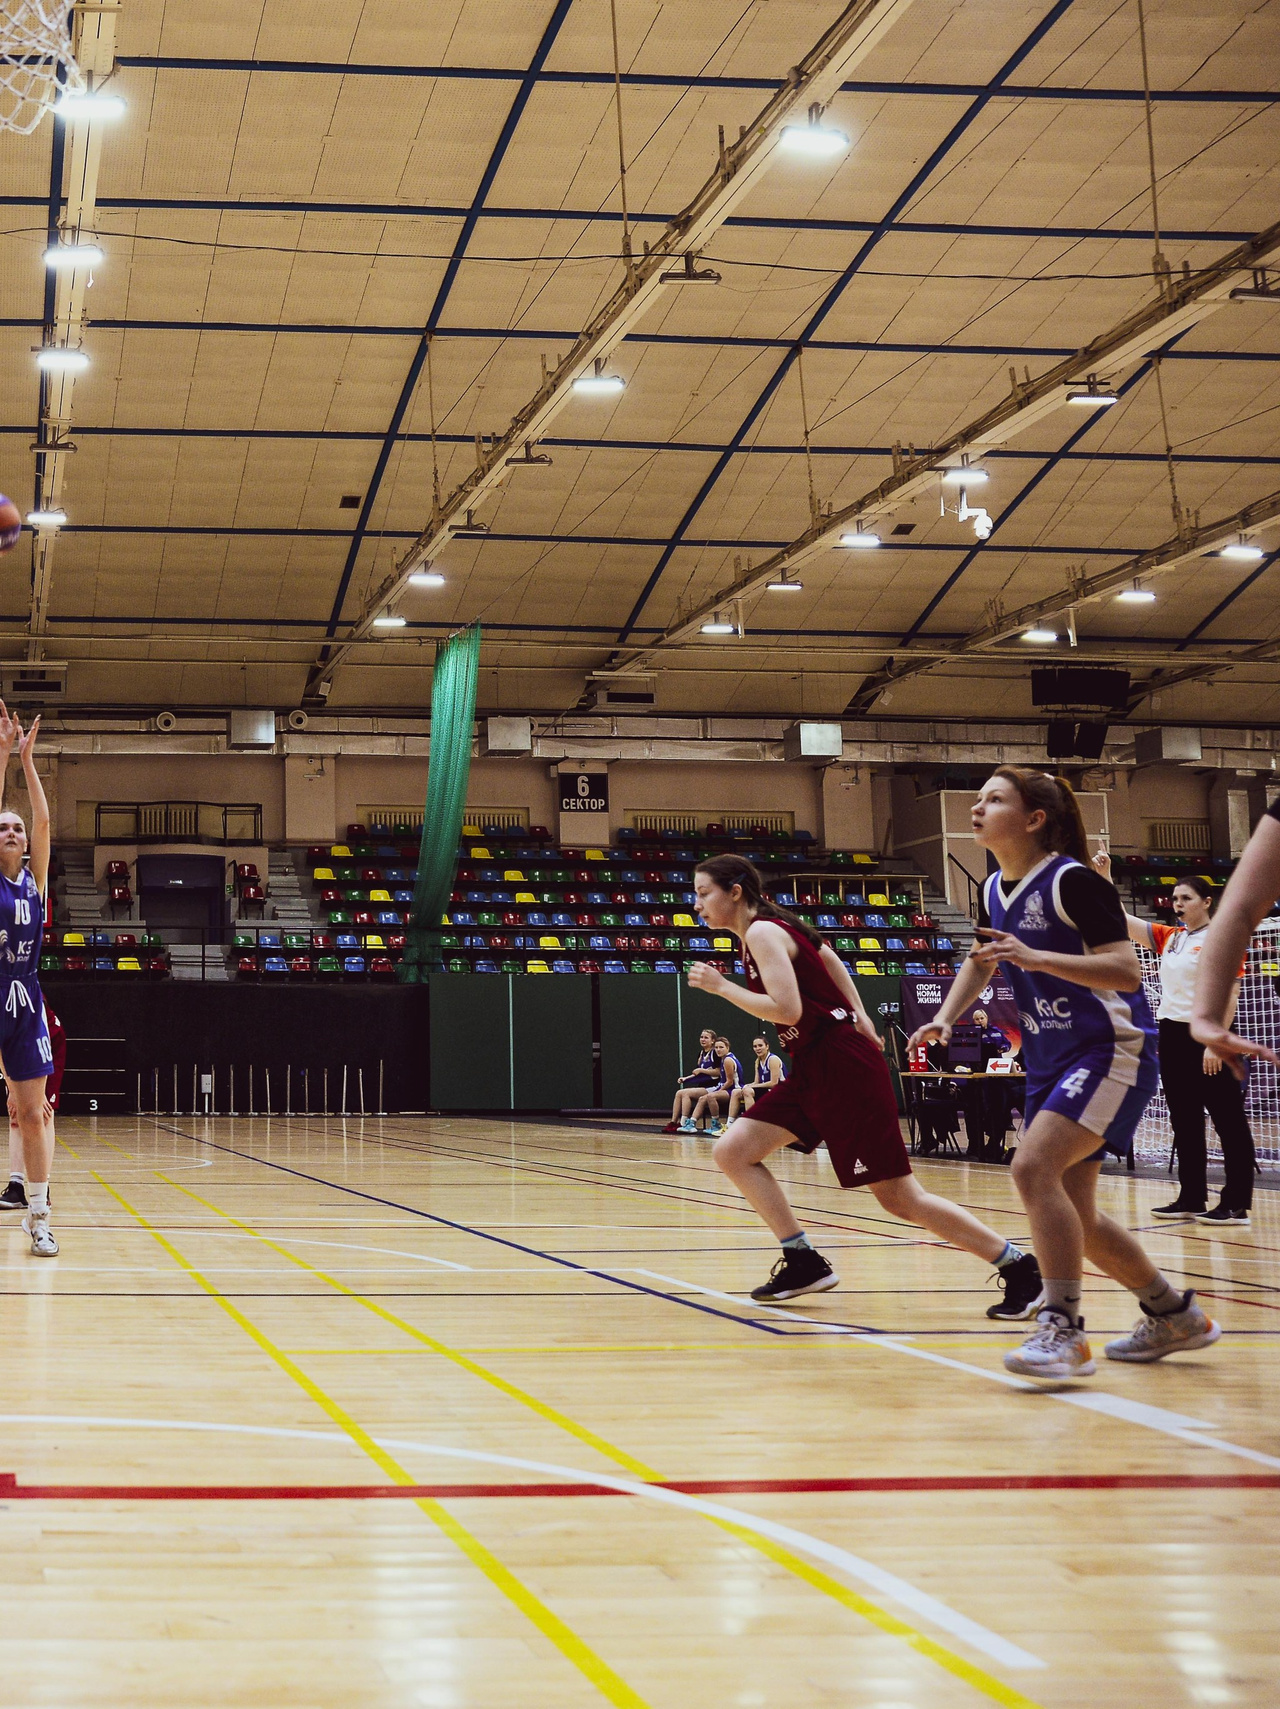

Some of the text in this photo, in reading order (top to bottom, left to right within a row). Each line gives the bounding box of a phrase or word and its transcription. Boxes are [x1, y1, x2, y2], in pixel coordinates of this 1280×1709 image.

[577, 775, 590, 797] 6
[562, 798, 605, 810] СЕКТОР
[14, 898, 31, 925] 10
[36, 1035, 53, 1063] 10
[917, 1047, 926, 1062] 5
[1060, 1067, 1091, 1099] 4
[89, 1099, 99, 1111] 3
